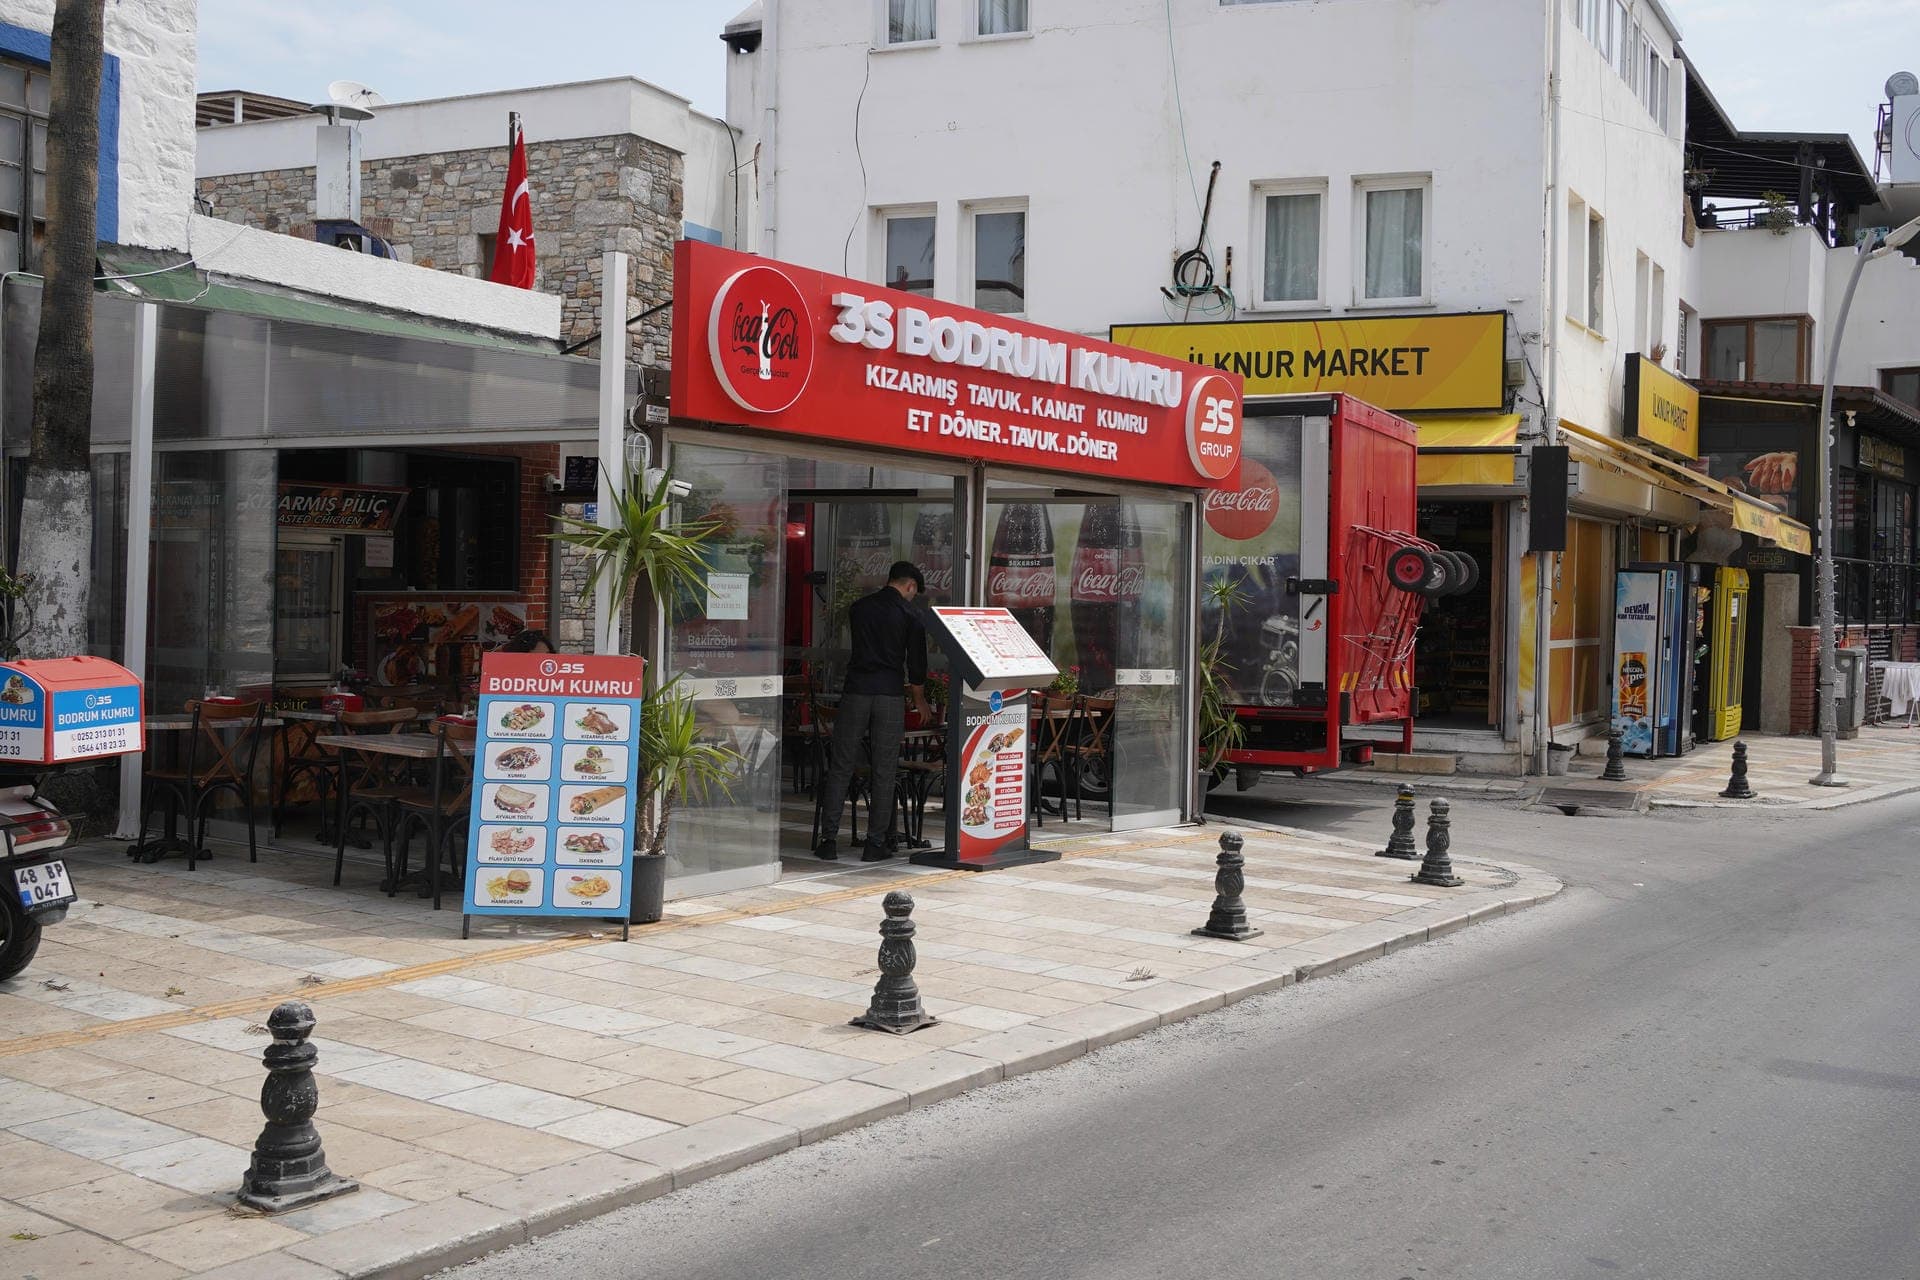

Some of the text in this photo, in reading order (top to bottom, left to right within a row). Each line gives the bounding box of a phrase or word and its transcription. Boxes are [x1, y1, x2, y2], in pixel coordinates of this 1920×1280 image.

[828, 292, 1183, 408] 3S BODRUM KUMRU
[1303, 347, 1430, 378] MARKET
[865, 363, 958, 407] KIZARMIŞ
[1096, 408, 1148, 435] KUMRU
[907, 408, 933, 432] ET
[1200, 395, 1234, 435] 3S
[1200, 441, 1233, 458] GROUP
[314, 514, 363, 525] CHICKEN
[1624, 603, 1650, 614] DEVAM
[489, 677, 634, 695] BODRUM KUMRU
[58, 706, 135, 725] BODRUM KUMRU
[966, 714, 999, 727] BODRUM
[77, 728, 126, 741] 0252 313 01 31
[10, 745, 21, 756] 33
[77, 739, 127, 753] 0546 418 23 33
[20, 863, 63, 886] 48 BP
[34, 882, 60, 901] 047
